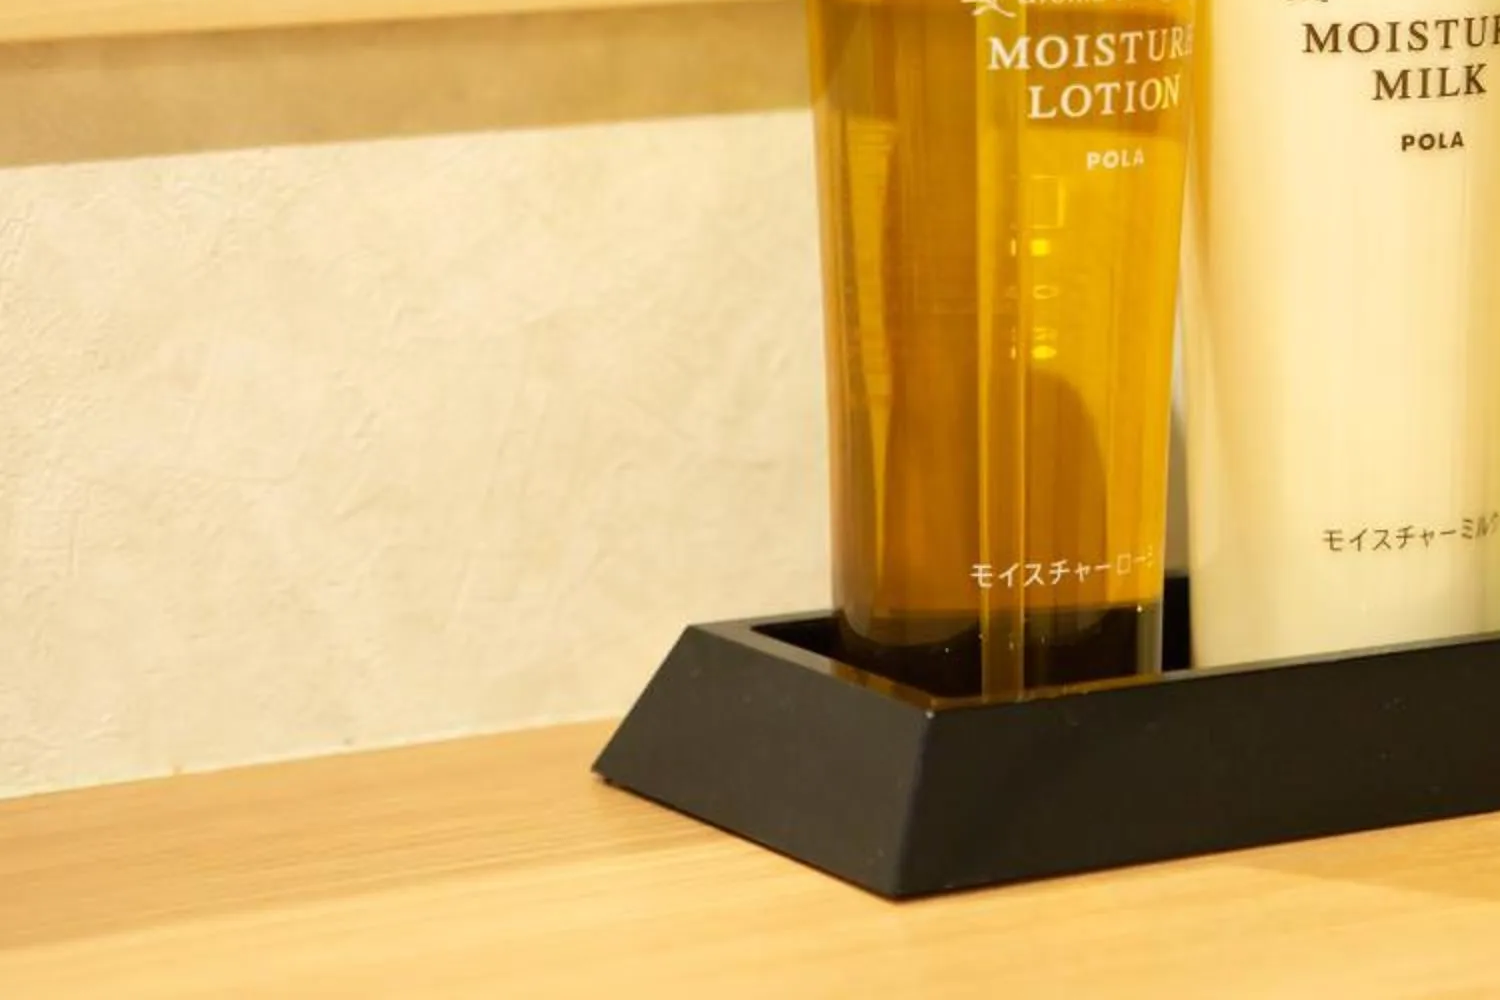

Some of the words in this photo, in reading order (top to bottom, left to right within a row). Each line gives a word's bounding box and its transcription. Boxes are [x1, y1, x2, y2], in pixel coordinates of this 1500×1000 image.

[1027, 73, 1181, 120] LOTION
[1371, 63, 1488, 102] MILK
[1086, 147, 1145, 170] POLA
[1400, 131, 1465, 152] POLA
[1322, 511, 1500, 552] モイスチャーミルク
